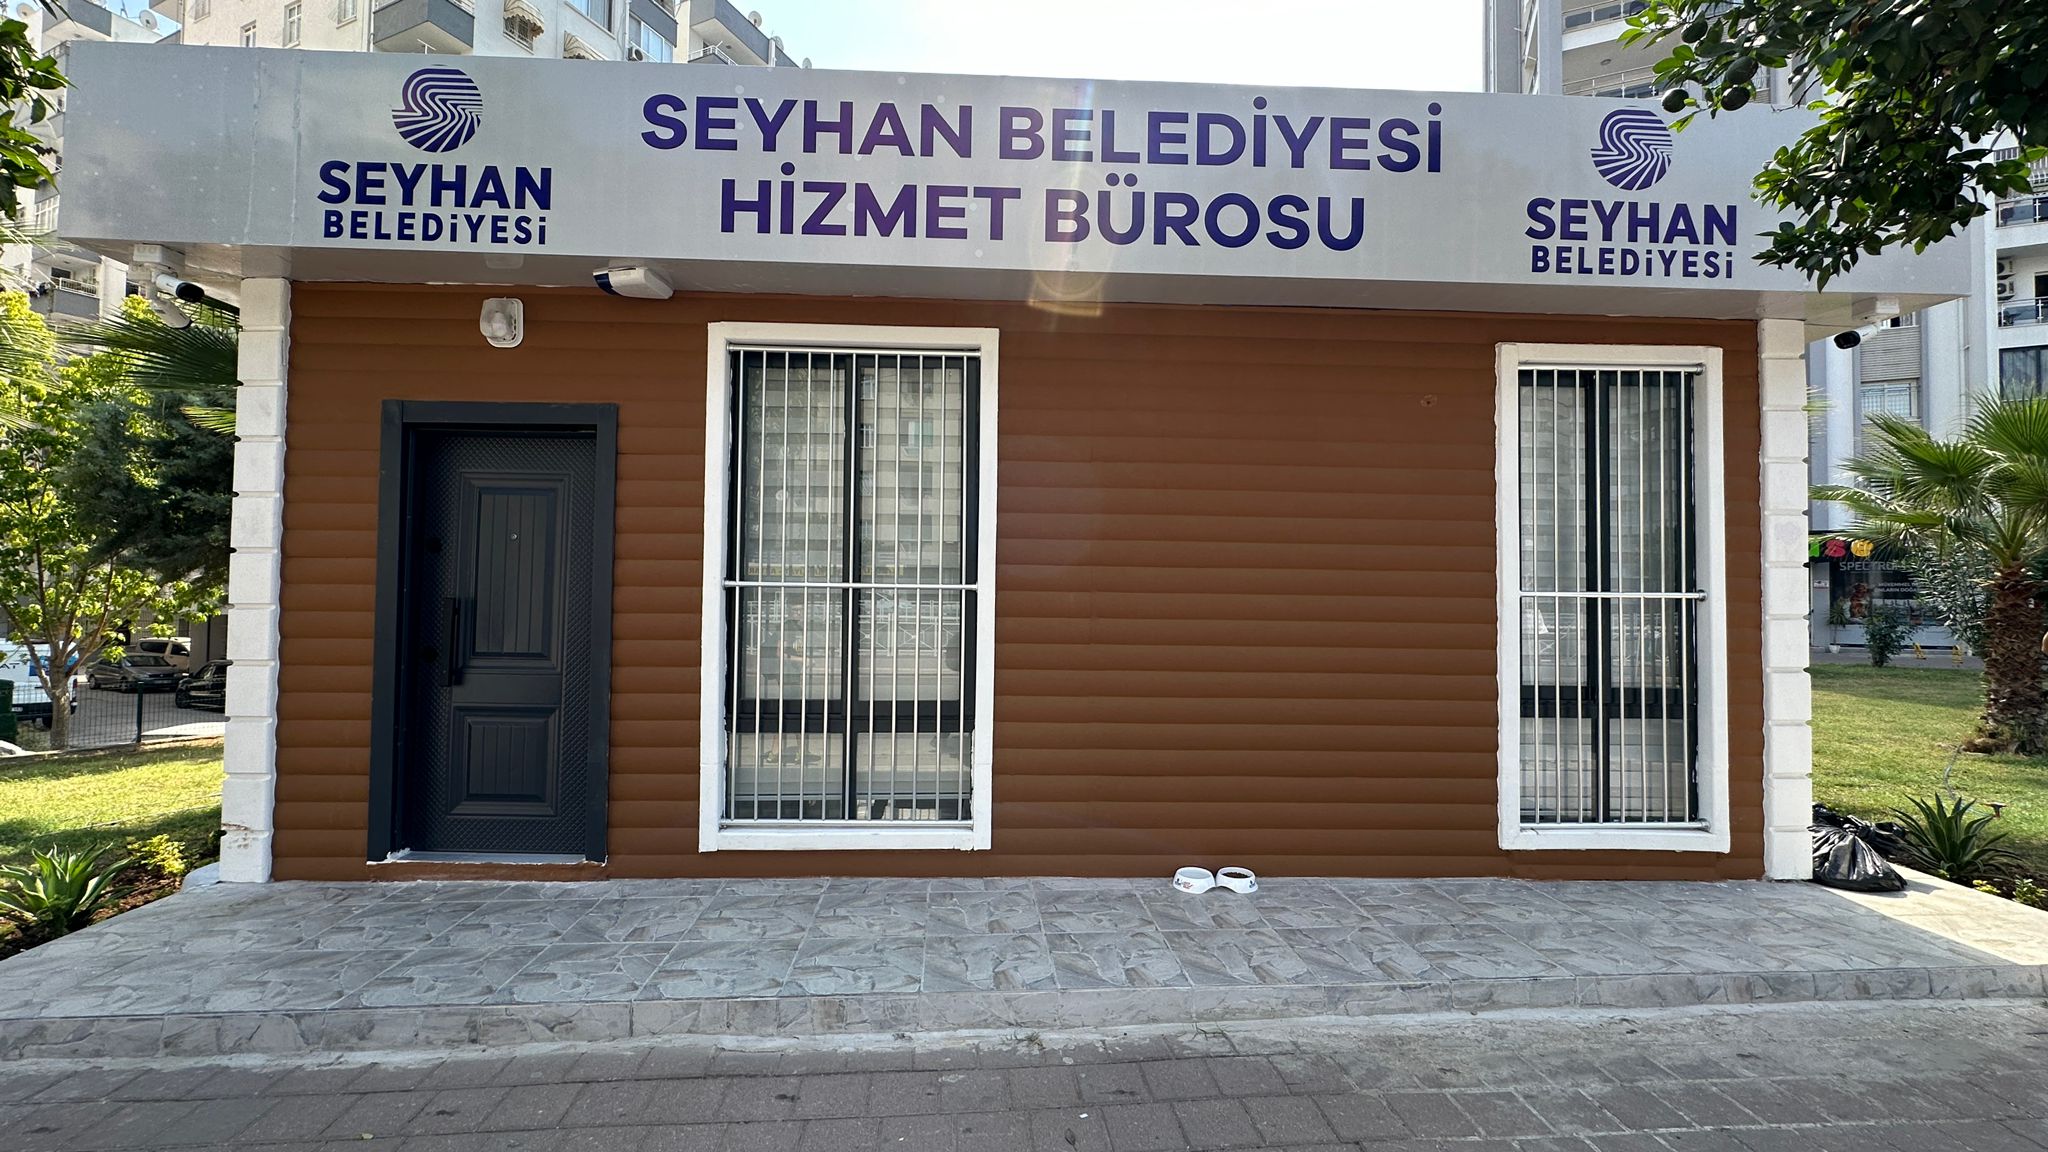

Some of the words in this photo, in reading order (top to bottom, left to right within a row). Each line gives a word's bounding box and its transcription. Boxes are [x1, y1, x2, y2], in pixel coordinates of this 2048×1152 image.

[640, 93, 973, 159] SEYHAN
[999, 96, 1442, 174] BELEDİYESİ
[316, 159, 552, 211] SEYHAN
[720, 161, 1022, 241] HİZMET
[1044, 172, 1365, 252] BÜROSU
[1524, 197, 1738, 246] SEYHAN
[1839, 561, 1900, 571] SPECTR
